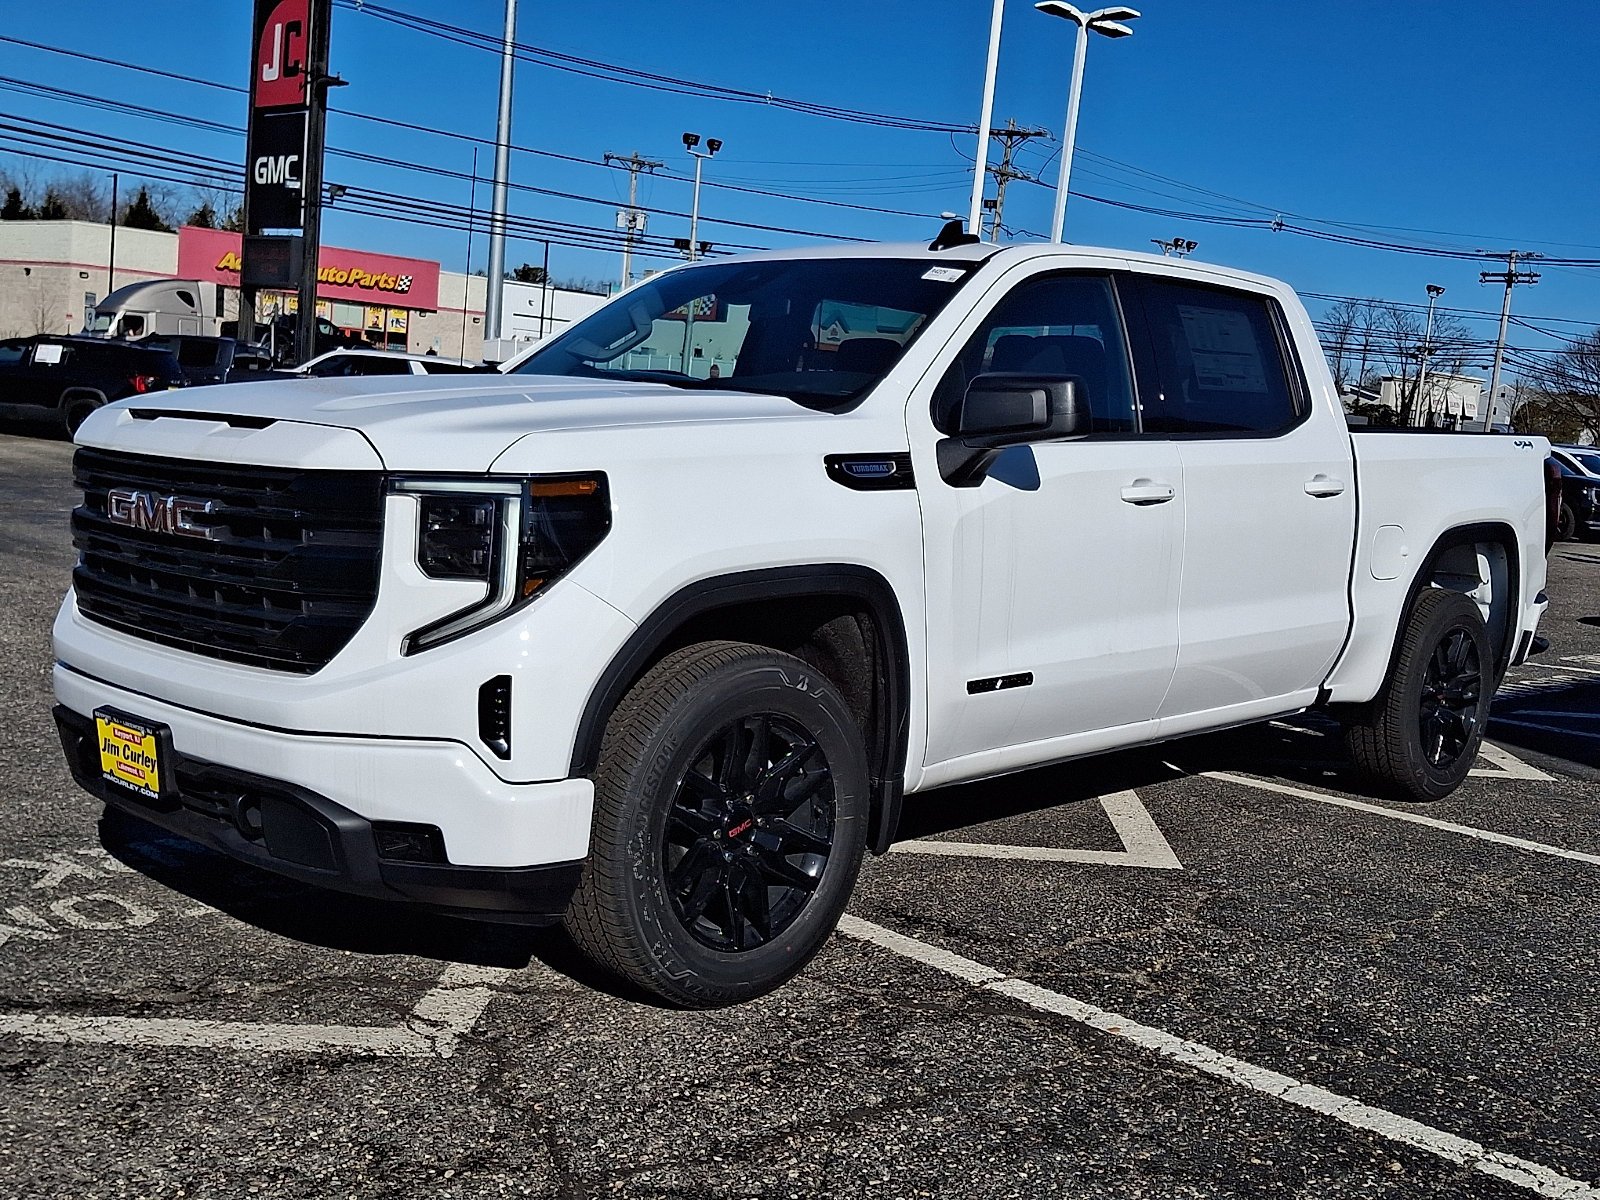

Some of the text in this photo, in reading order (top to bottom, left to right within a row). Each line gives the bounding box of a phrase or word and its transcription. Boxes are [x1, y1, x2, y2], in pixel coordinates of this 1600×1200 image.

[262, 20, 302, 82] JC
[255, 155, 299, 184] GMC
[851, 464, 889, 473] TURBOMAX
[108, 489, 217, 541] GMC
[101, 737, 157, 774] Jim Curley
[102, 773, 159, 800] JIMCURLEY.COM
[728, 818, 752, 838] GMC
